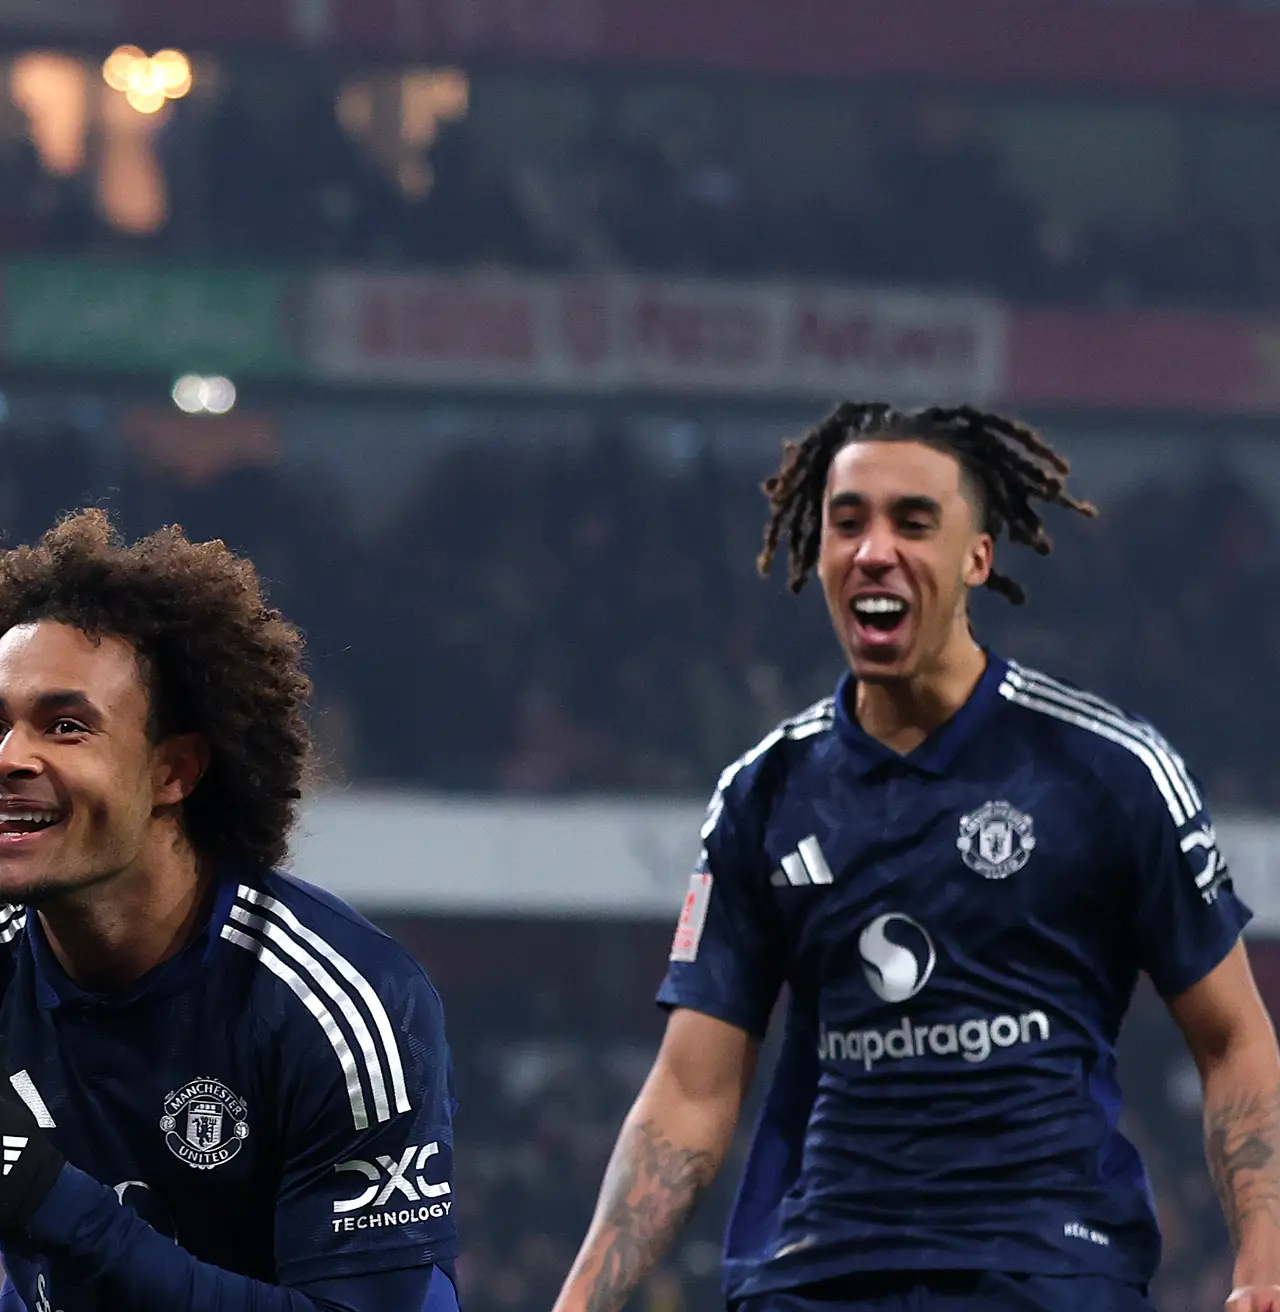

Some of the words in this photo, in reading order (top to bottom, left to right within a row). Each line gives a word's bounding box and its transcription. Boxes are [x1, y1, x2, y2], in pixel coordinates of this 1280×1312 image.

[171, 1083, 242, 1115] MANCHESTER
[179, 1145, 228, 1163] UNITED
[333, 1141, 451, 1206] DXC
[332, 1202, 452, 1232] TECHNOLOGY
